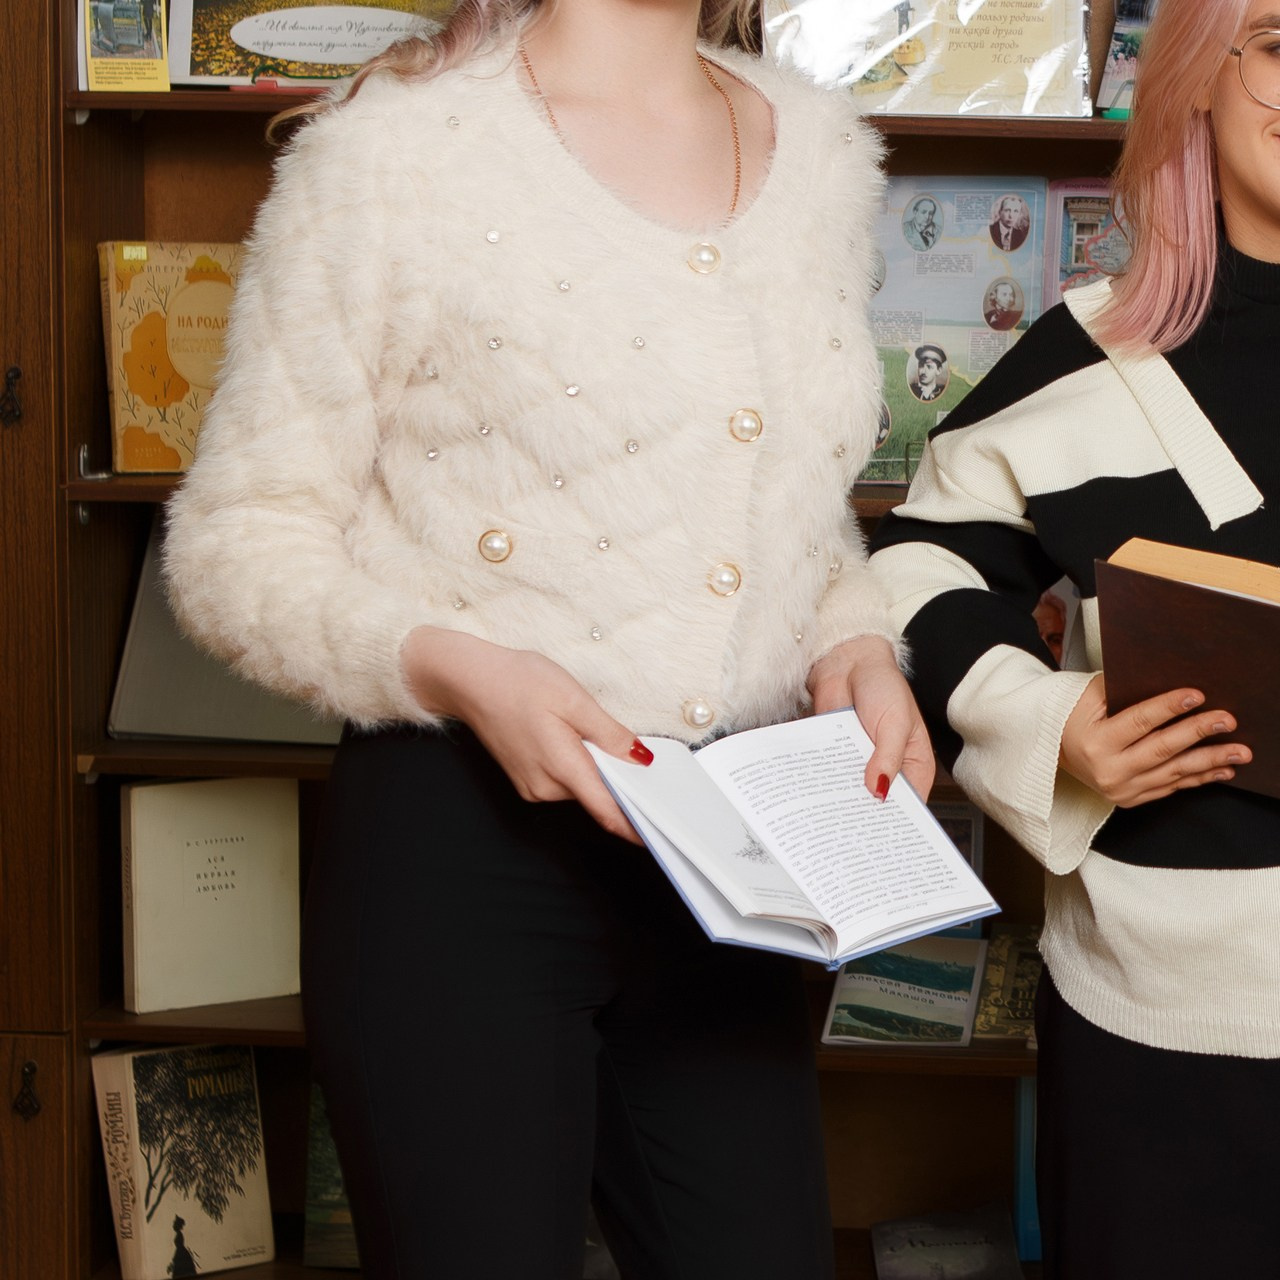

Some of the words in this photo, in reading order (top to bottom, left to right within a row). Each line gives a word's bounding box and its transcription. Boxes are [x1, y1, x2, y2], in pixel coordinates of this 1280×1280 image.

[976, 14, 1007, 24] пользу
[1009, 13, 1045, 24] родины
[962, 26, 990, 36] какой
[992, 27, 1023, 38] другой
[948, 40, 985, 51] русский
[177, 316, 193, 329] НА
[848, 974, 901, 988] Алексей
[908, 985, 969, 1004] Иванович
[106, 1090, 125, 1145] РОМАНЫ
